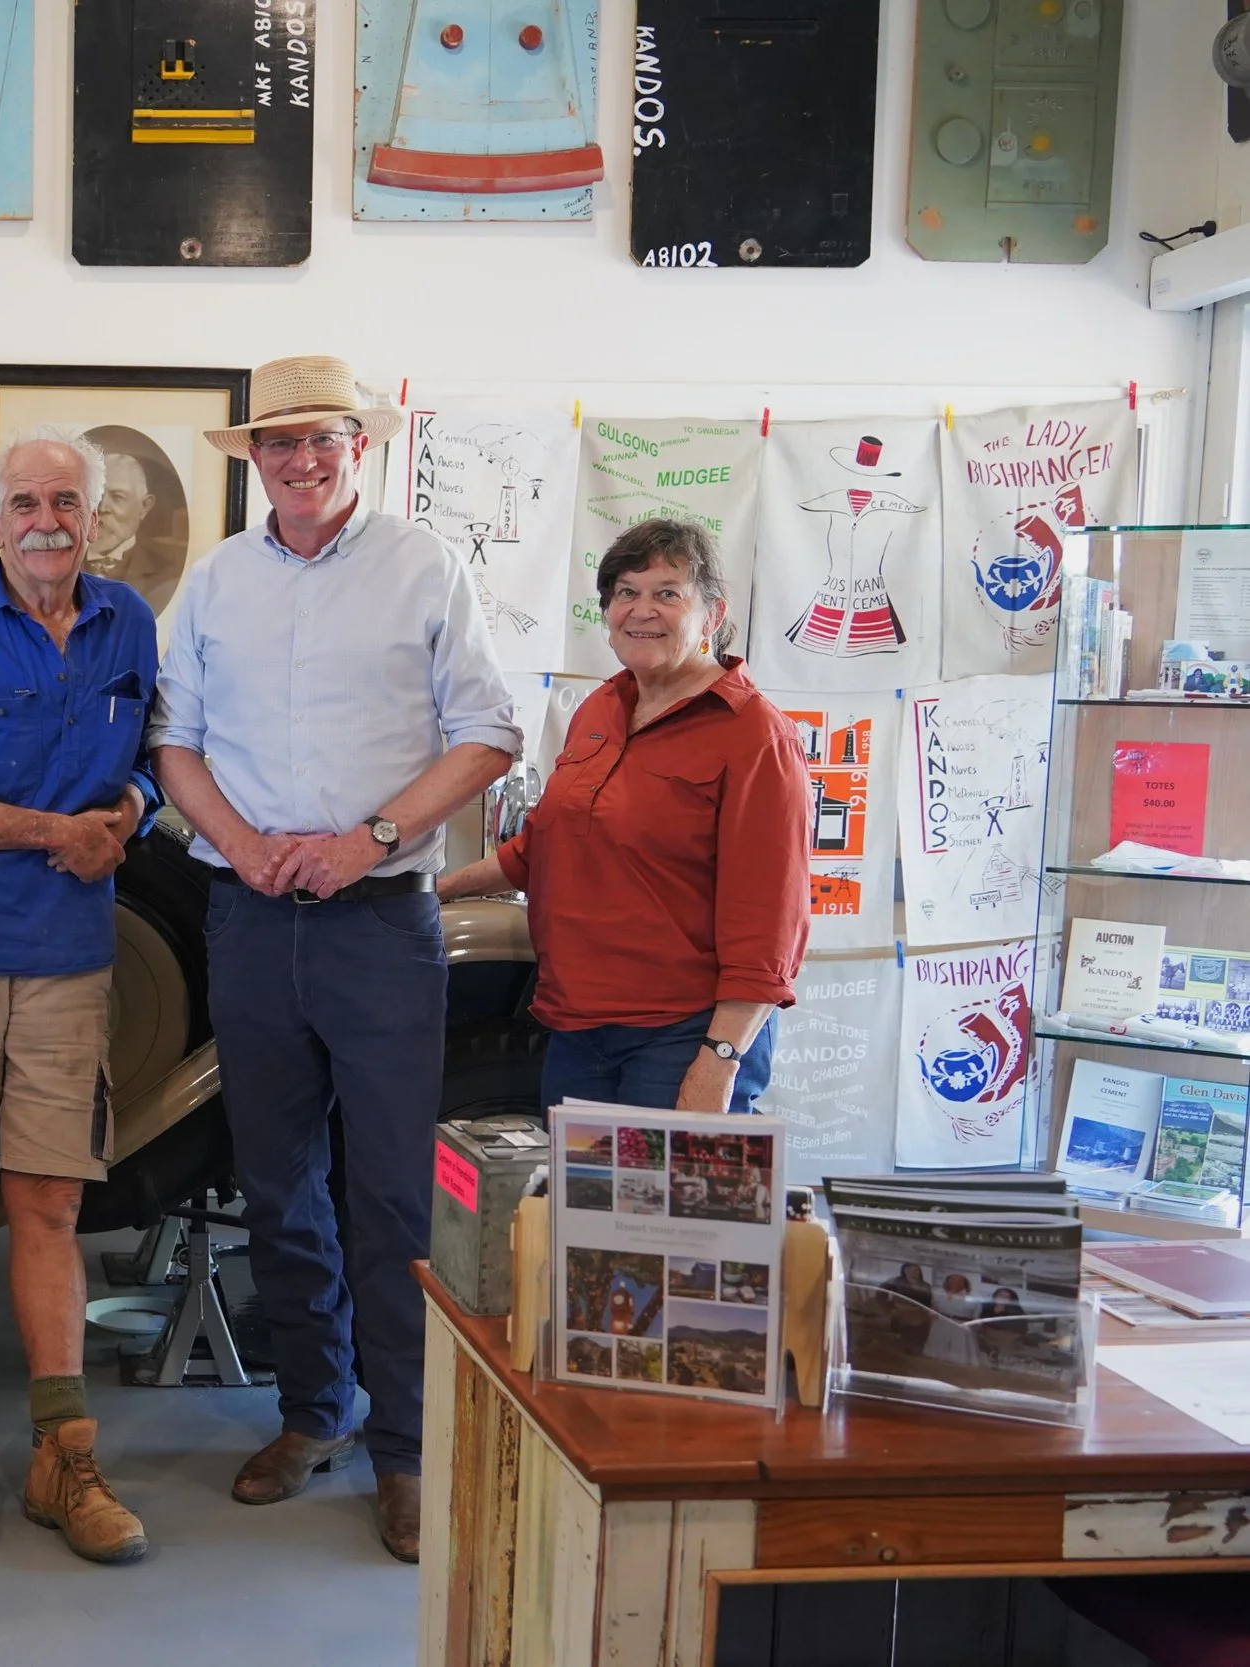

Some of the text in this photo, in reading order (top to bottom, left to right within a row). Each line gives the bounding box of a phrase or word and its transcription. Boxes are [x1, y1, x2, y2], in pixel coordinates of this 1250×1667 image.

[597, 422, 659, 457] GULGONG
[683, 426, 740, 435] TO GWABEGAR
[983, 420, 1087, 453] THE LADY
[602, 451, 638, 462] MUNNA
[967, 442, 1113, 488] BUSHRANGER
[656, 466, 731, 488] MUDGEE
[586, 505, 622, 526] HAVILAH
[862, 730, 872, 754] 1958
[1145, 781, 1175, 791] TOTES
[1143, 798, 1176, 808] $40.00
[822, 903, 854, 914] 1915
[1095, 932, 1135, 946] AUCTION
[1087, 967, 1133, 978] KANDOS
[806, 978, 878, 1001] MUDGEE
[809, 1018, 870, 1041] RYLSTONE
[772, 1044, 868, 1065] KANDOS
[812, 1061, 860, 1083] CHARBON
[1102, 1077, 1130, 1088] KANDOS
[1100, 1088, 1128, 1098] CEMENT
[1179, 1084, 1247, 1102] Glen Davis
[834, 1099, 869, 1118] VULCAN
[801, 1135, 820, 1149] Ben
[822, 1130, 851, 1146] Bullen
